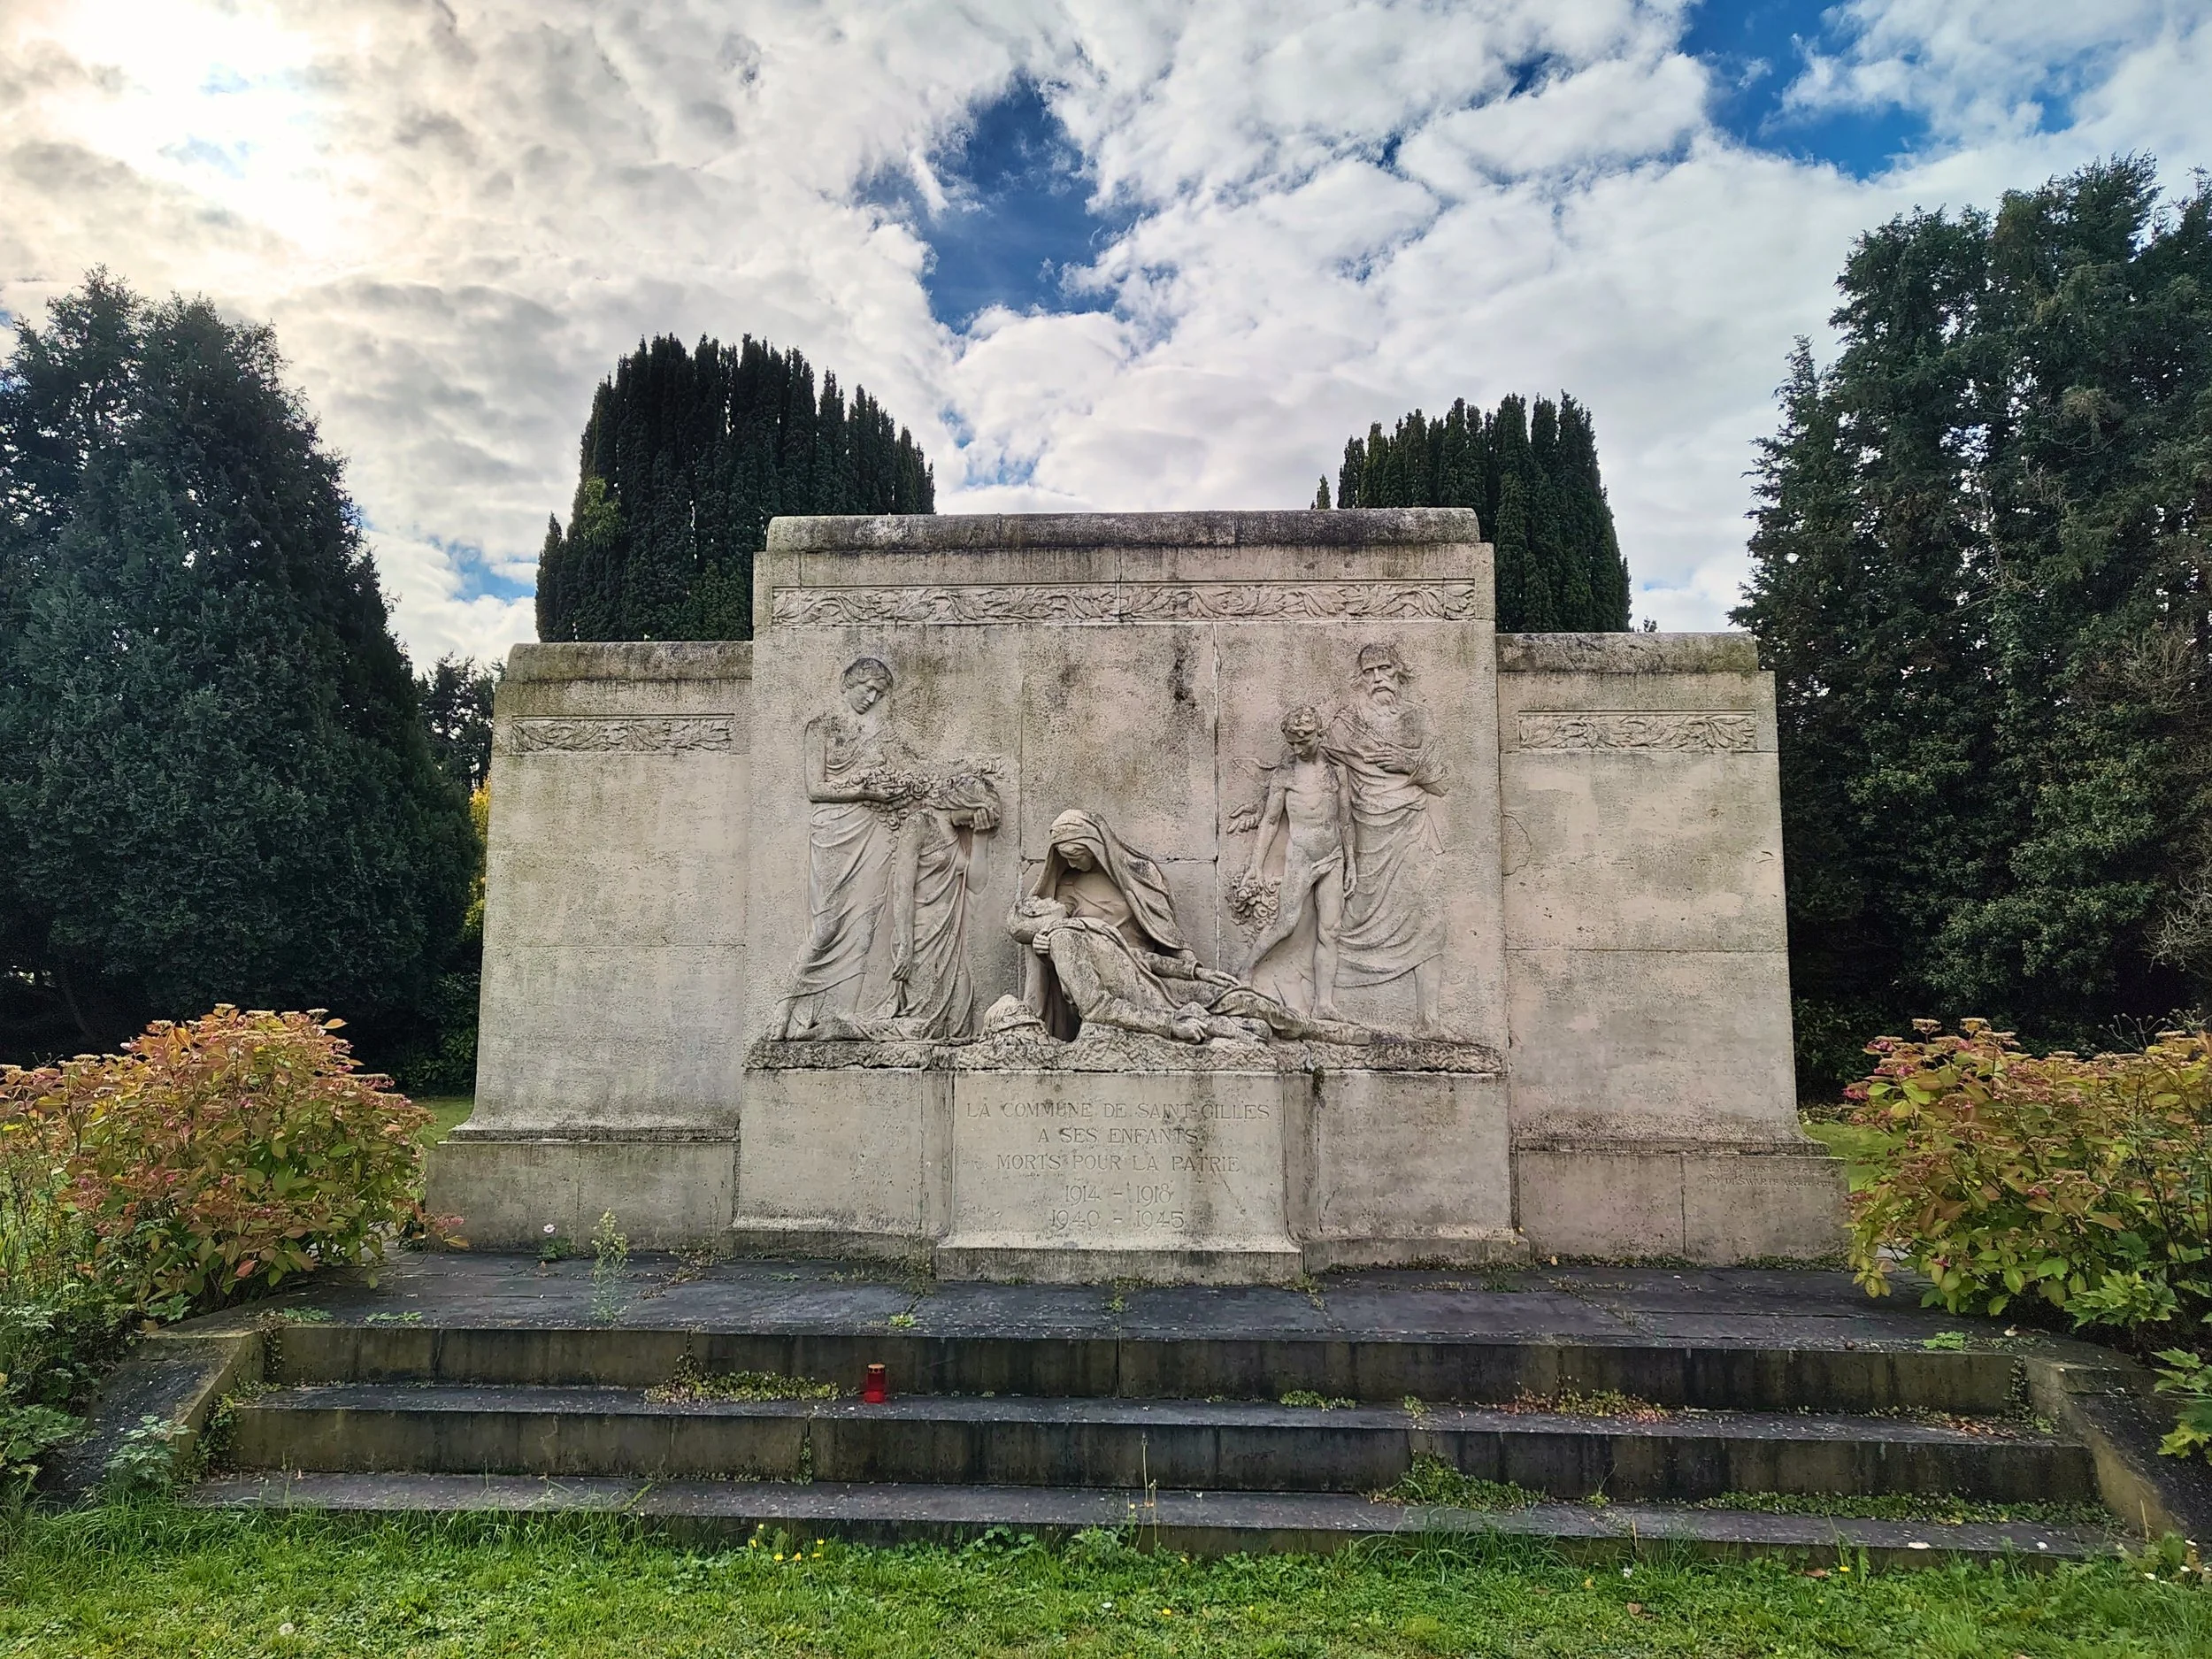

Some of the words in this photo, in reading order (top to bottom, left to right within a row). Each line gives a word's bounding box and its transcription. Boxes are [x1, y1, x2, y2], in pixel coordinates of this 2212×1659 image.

[967, 1103, 991, 1118] LA
[1003, 1102, 1093, 1118] COMMUNE
[1104, 1103, 1126, 1118] DE
[1137, 1103, 1270, 1119] SAINT-GILLES
[1039, 1128, 1049, 1142] A
[1061, 1128, 1098, 1143] SES
[1109, 1128, 1199, 1144] ENFANTS
[997, 1155, 1061, 1171] MORTS
[1072, 1156, 1121, 1171] POUR
[1133, 1156, 1158, 1171] LA
[1172, 1156, 1240, 1172] PATRIE
[1064, 1185, 1101, 1206] 1914
[1137, 1183, 1173, 1206] 1918
[1052, 1210, 1100, 1229] 1940
[1137, 1210, 1184, 1230] 1945
